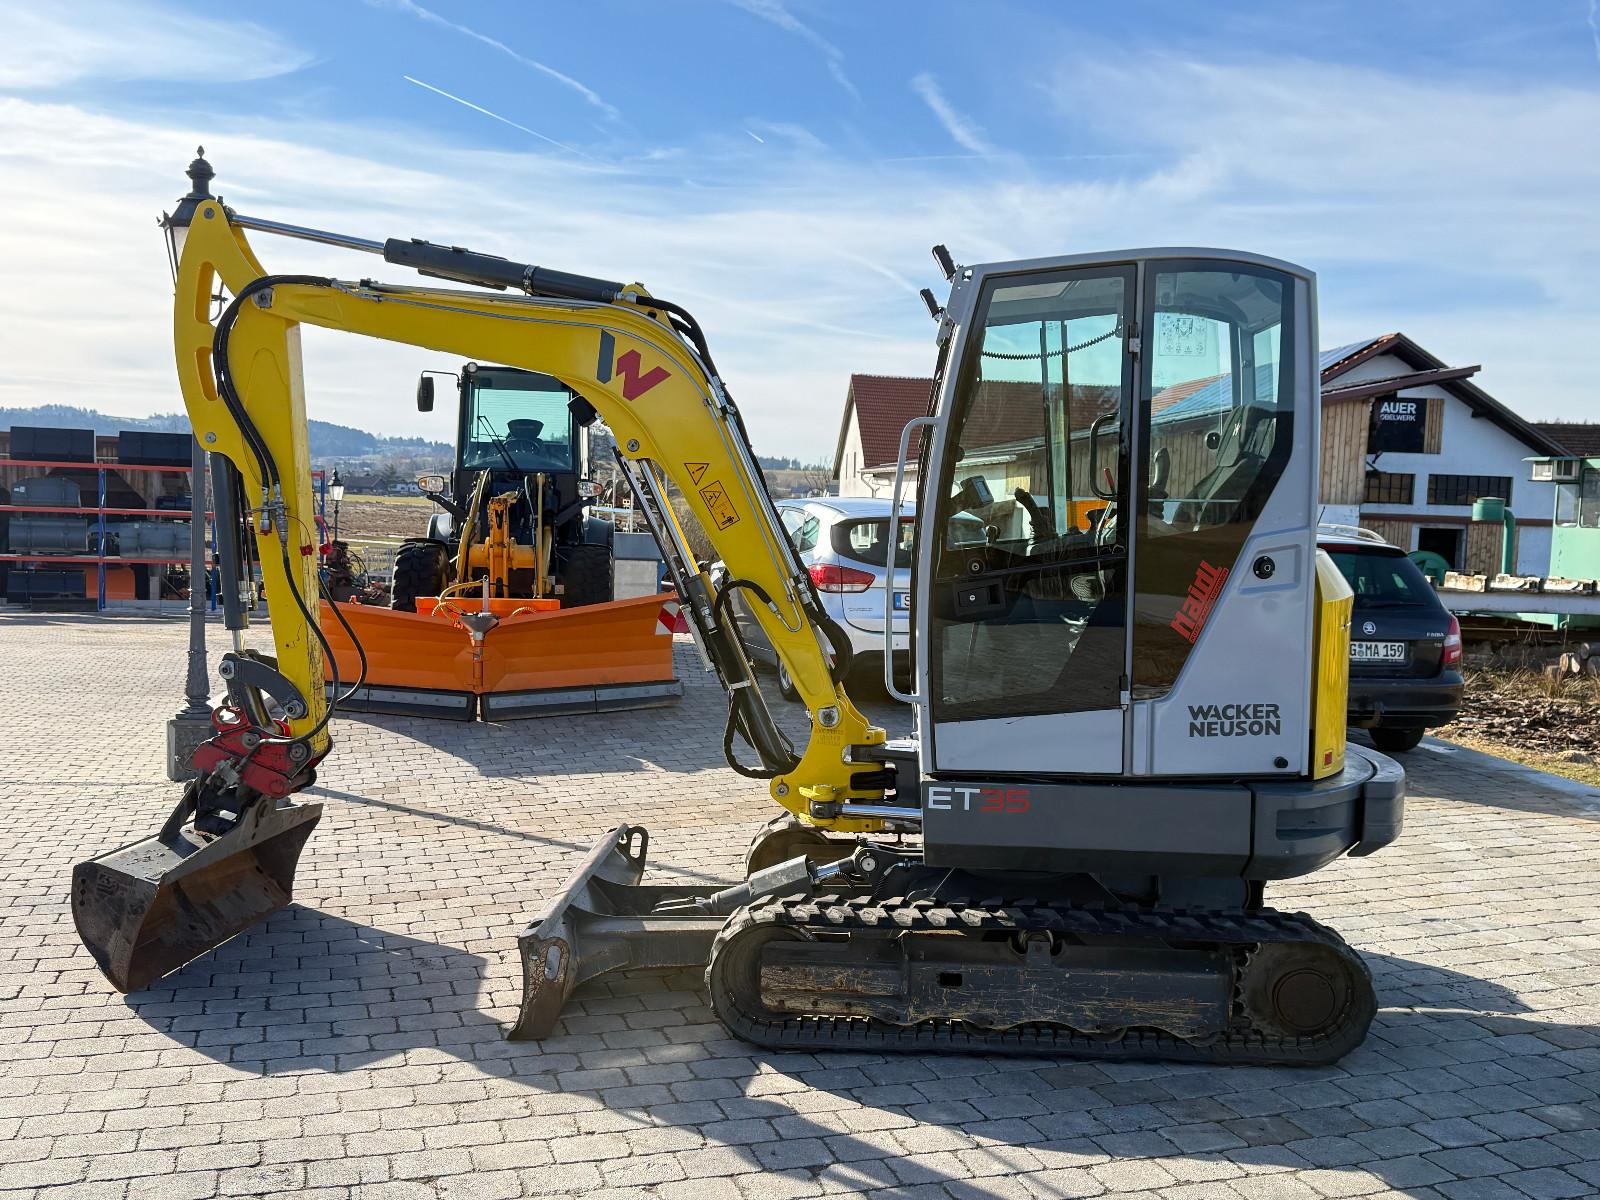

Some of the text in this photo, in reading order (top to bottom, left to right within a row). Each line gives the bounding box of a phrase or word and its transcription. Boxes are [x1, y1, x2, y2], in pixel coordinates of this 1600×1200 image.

[1380, 402, 1417, 414] AUER
[1365, 643, 1380, 657] MA
[1382, 644, 1404, 658] 159
[1187, 704, 1280, 720] WACKER
[1189, 720, 1280, 737] NEUSON
[928, 786, 1031, 813] ET35
